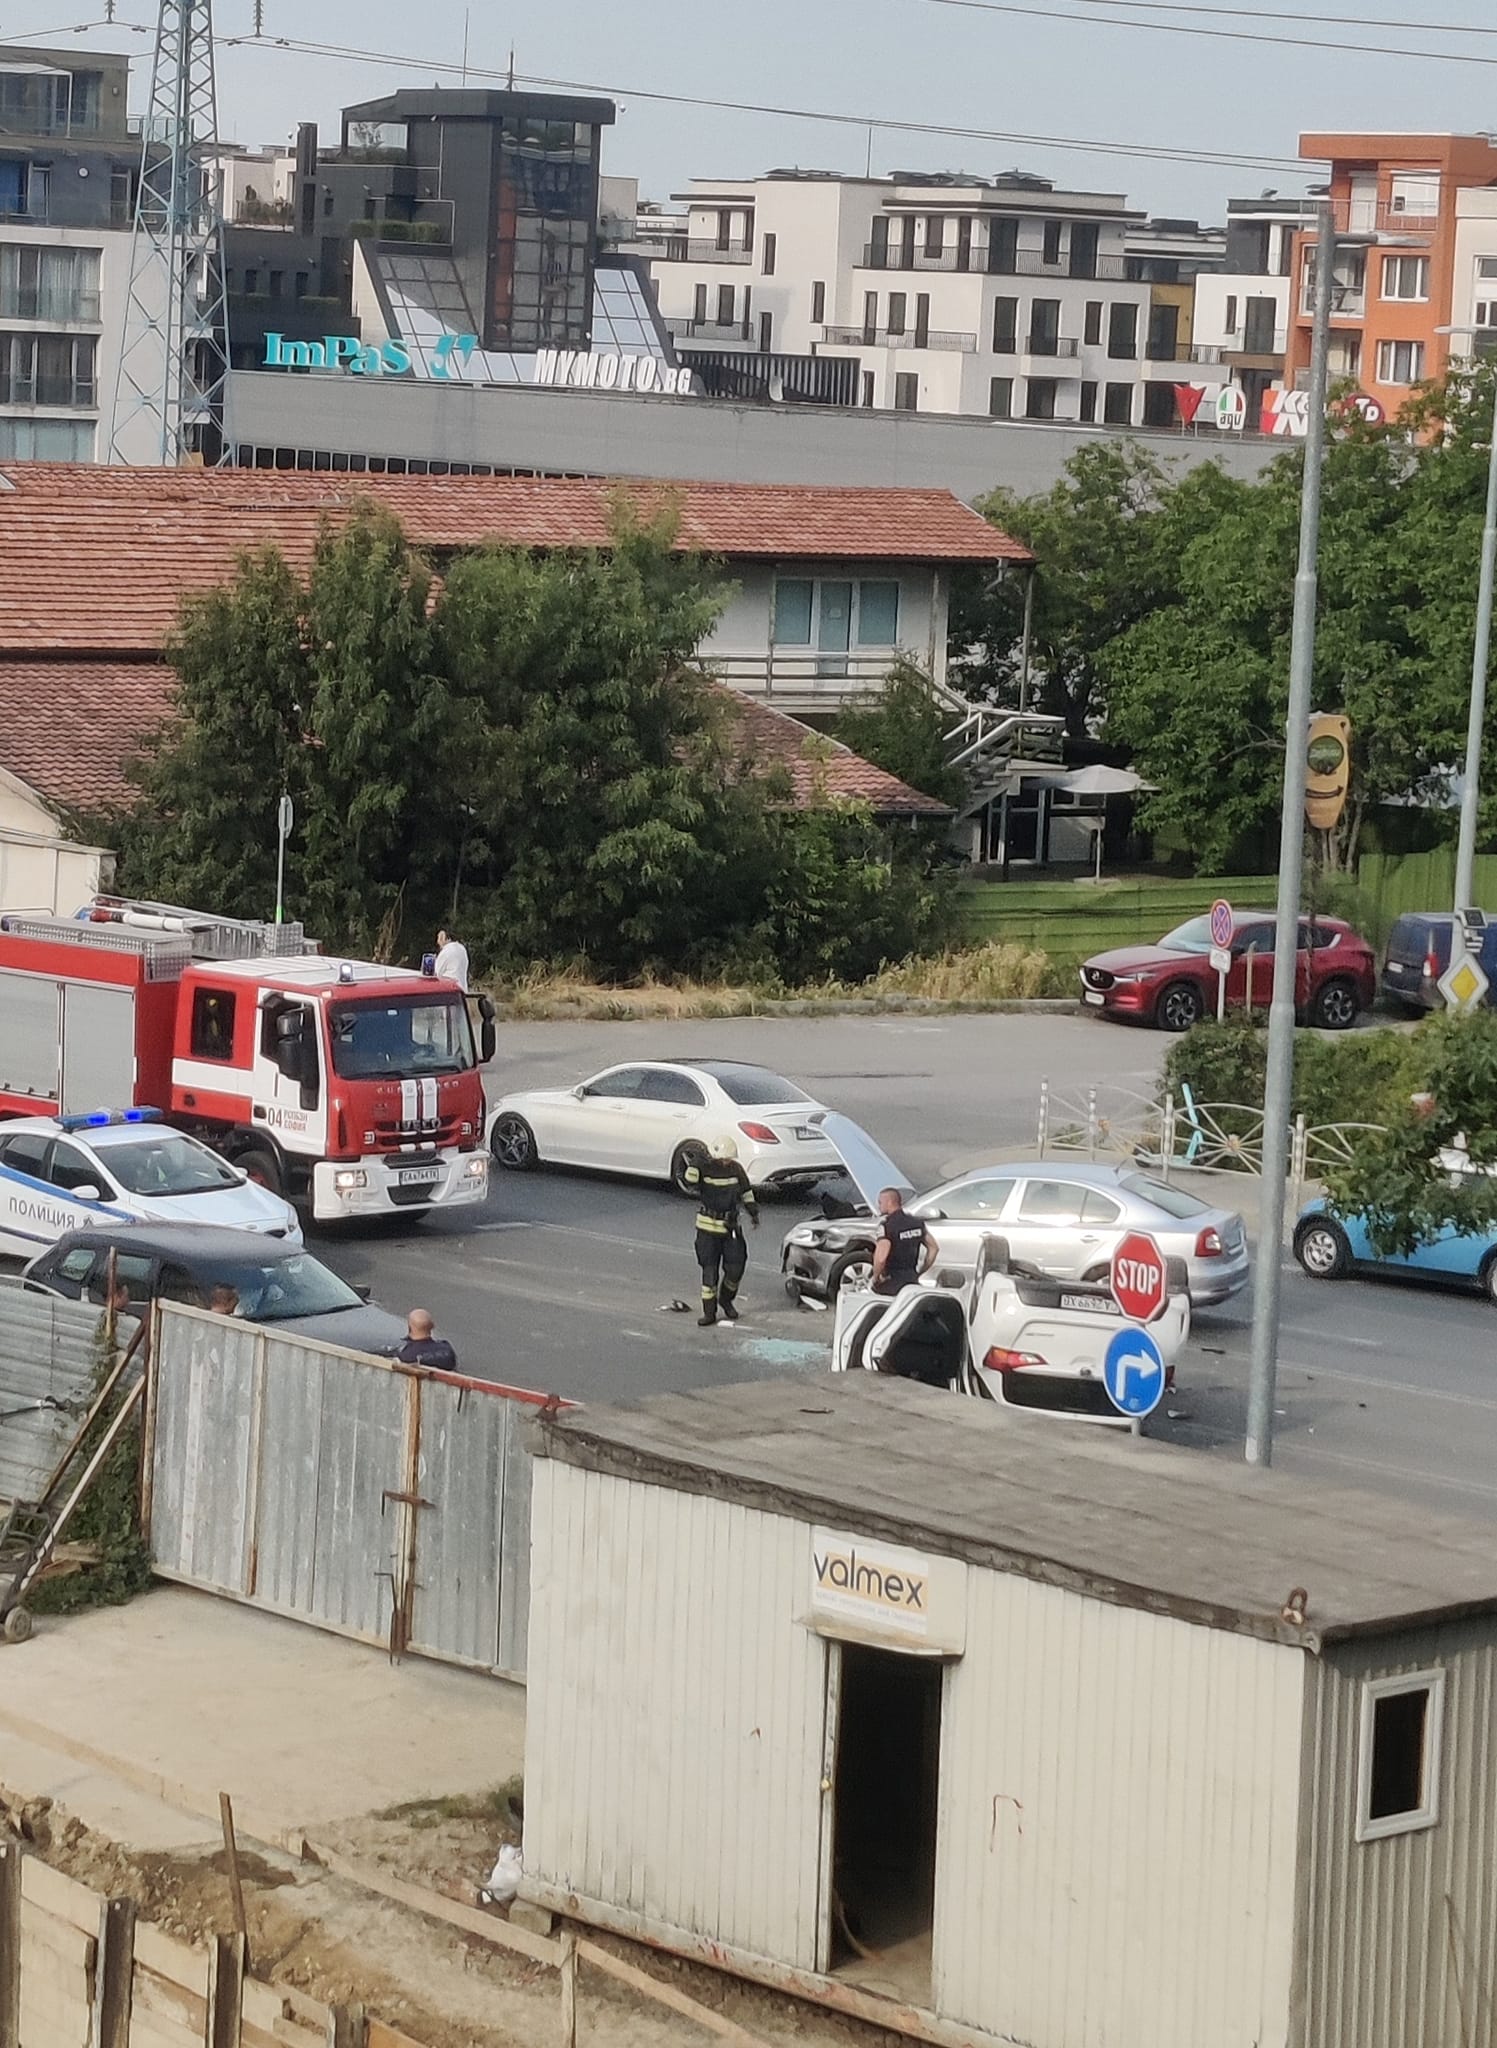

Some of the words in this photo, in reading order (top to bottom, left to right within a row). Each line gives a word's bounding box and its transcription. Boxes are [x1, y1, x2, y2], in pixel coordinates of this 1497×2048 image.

[262, 332, 411, 374] ImPaS
[268, 1107, 283, 1129] 04
[9, 1196, 76, 1230] ПОЛИЦИЯ
[1116, 1258, 1160, 1296] STOP
[813, 1548, 923, 1608] valmex
